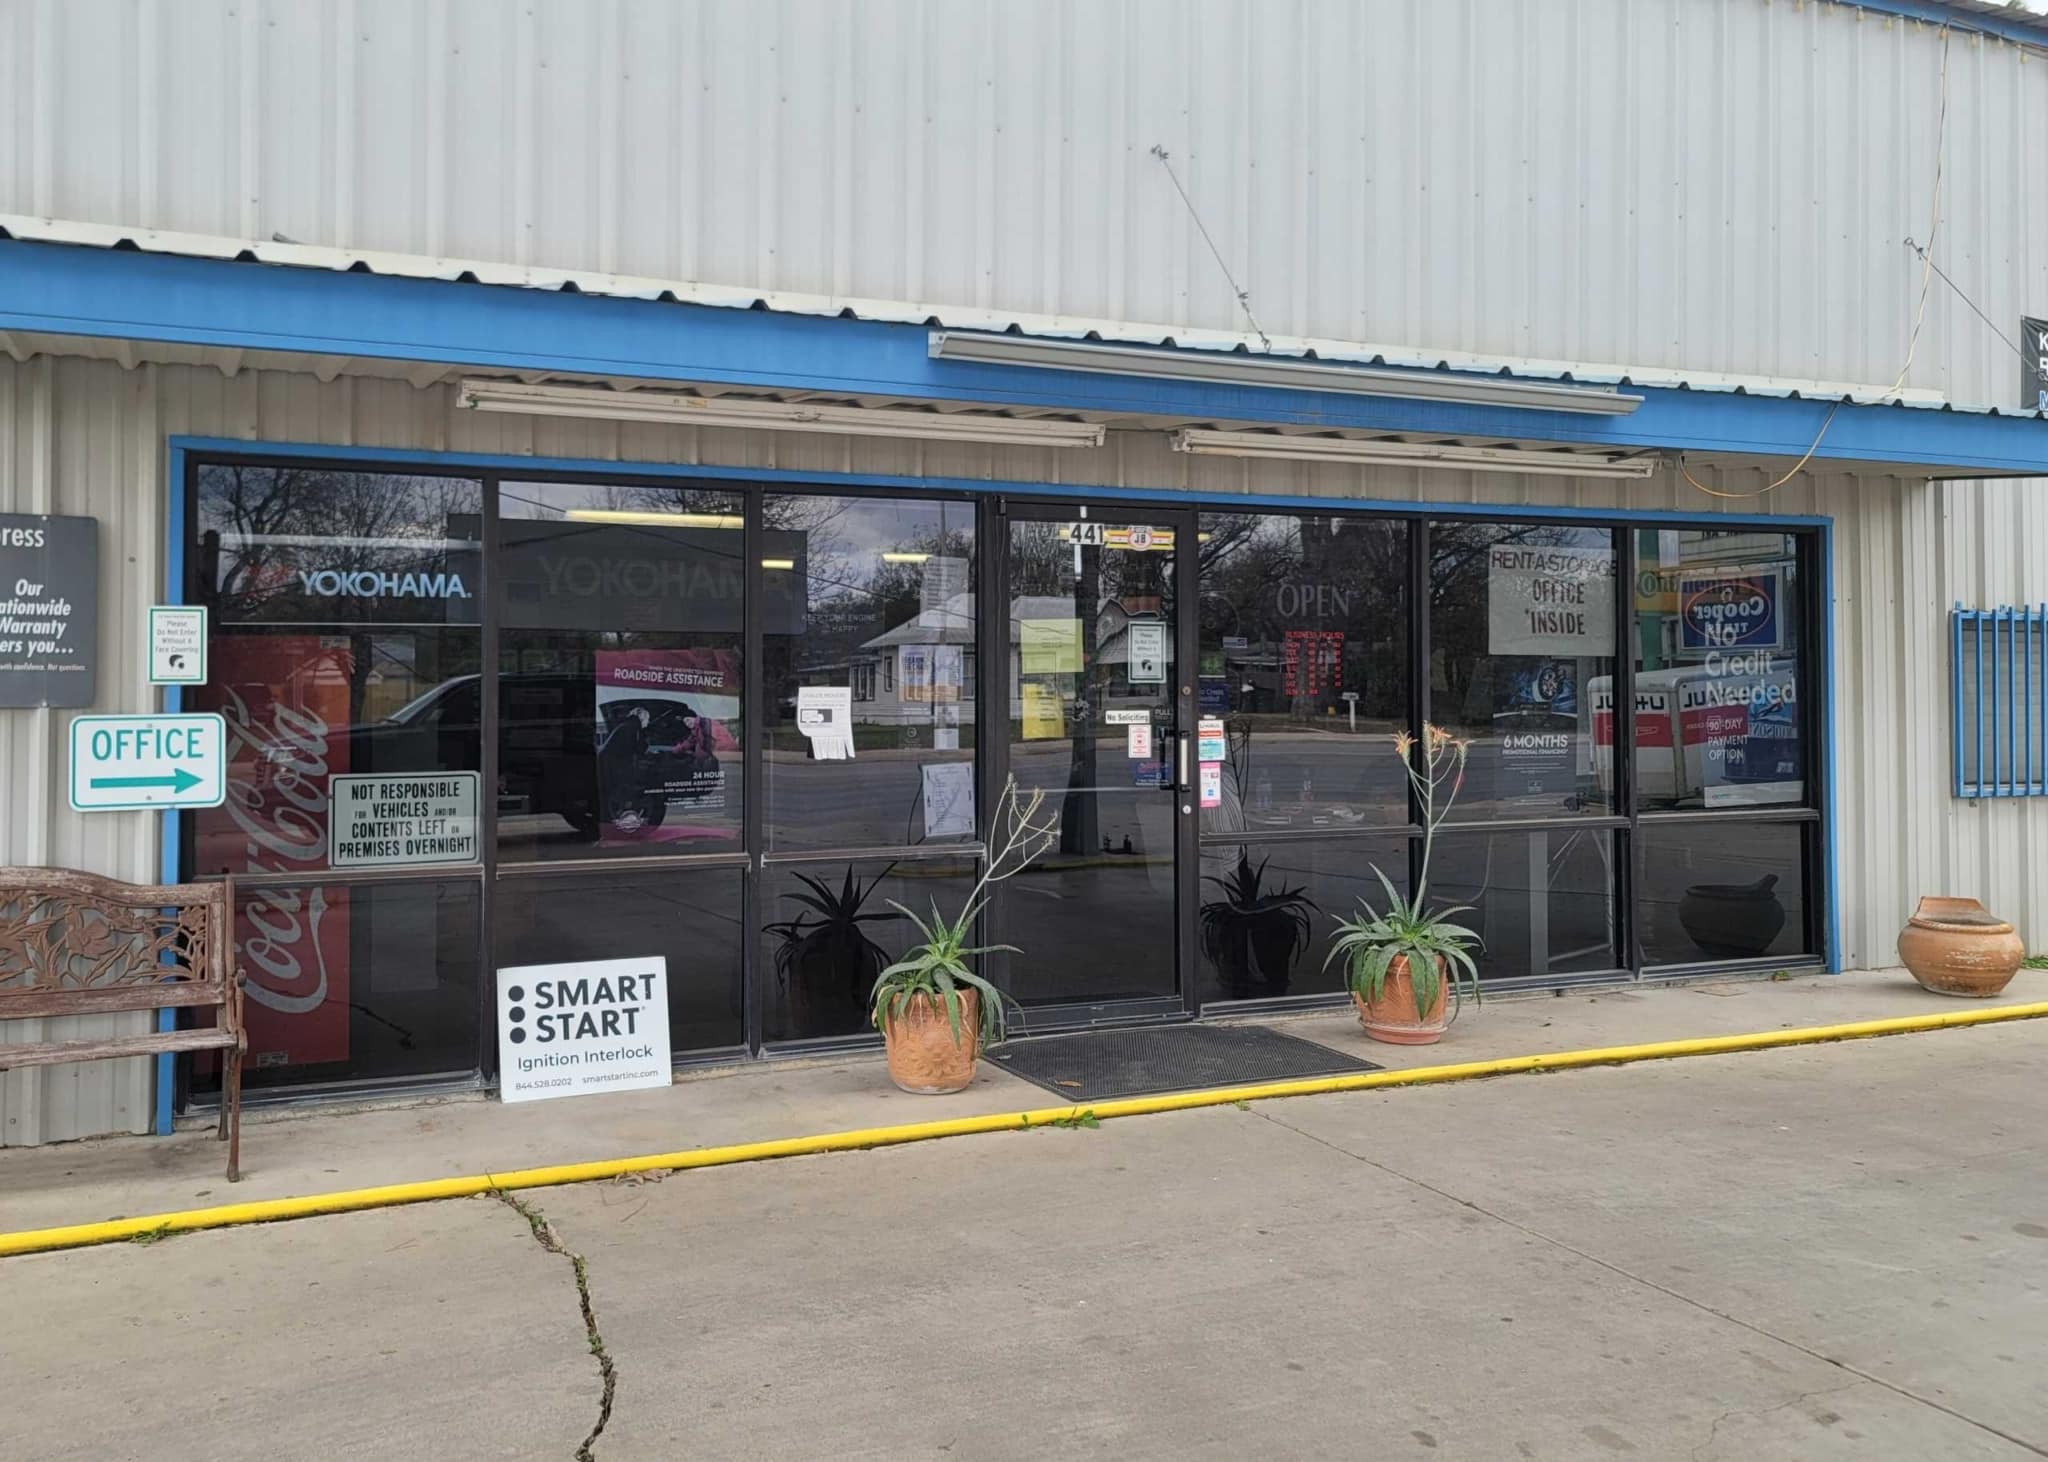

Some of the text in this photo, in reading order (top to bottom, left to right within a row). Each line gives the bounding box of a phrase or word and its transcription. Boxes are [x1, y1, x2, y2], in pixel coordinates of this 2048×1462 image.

[0, 527, 44, 548] ress
[1070, 524, 1103, 544] 441
[15, 578, 44, 596] Our
[1533, 579, 1584, 604] OFFICE
[1277, 584, 1349, 616] OPEN
[0, 616, 66, 639] Warranty
[1531, 611, 1585, 635] INSIDE
[0, 641, 74, 658] ers you...
[1705, 651, 1773, 676] Credit
[614, 668, 723, 688] ROADSIDE ASSISTANCE
[1706, 677, 1796, 706] Needed
[1107, 713, 1149, 722] No Soliciting
[92, 728, 204, 761] OFFICE
[1504, 735, 1569, 748] 6 MONTHS
[1708, 735, 1749, 747] PAYMENT
[1709, 749, 1744, 760] OPTION
[352, 782, 460, 800] NOT RESPONSIBLE
[354, 810, 366, 819] FOR
[373, 802, 429, 818] VEHICLES
[352, 821, 412, 838] CONTENTS
[419, 819, 446, 835] LEFT
[339, 837, 472, 859] PREMISES OVERNIGHT
[535, 973, 656, 1009] SMART
[536, 1007, 640, 1043] START
[518, 1044, 653, 1073] Ignition Interlock
[582, 1069, 659, 1084] smartstartinc.com
